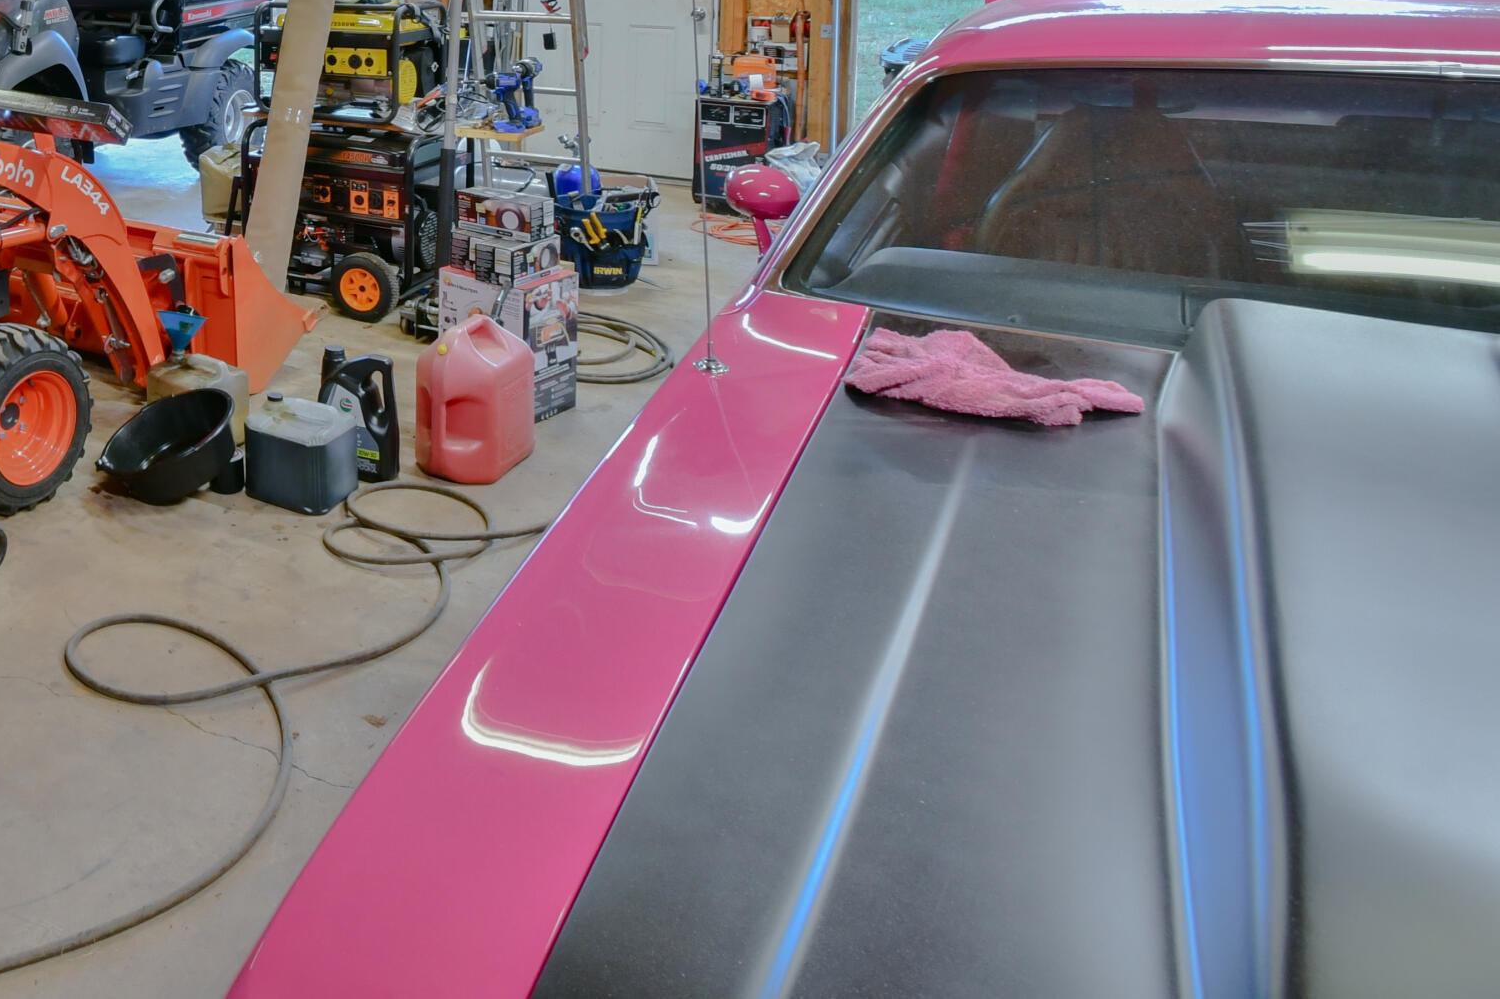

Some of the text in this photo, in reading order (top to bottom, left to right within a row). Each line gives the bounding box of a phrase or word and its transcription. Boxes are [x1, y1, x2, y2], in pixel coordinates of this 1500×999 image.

[704, 149, 749, 162] CRAFTSMAN
[60, 165, 110, 215] LA344
[593, 266, 624, 275] IRWIN
